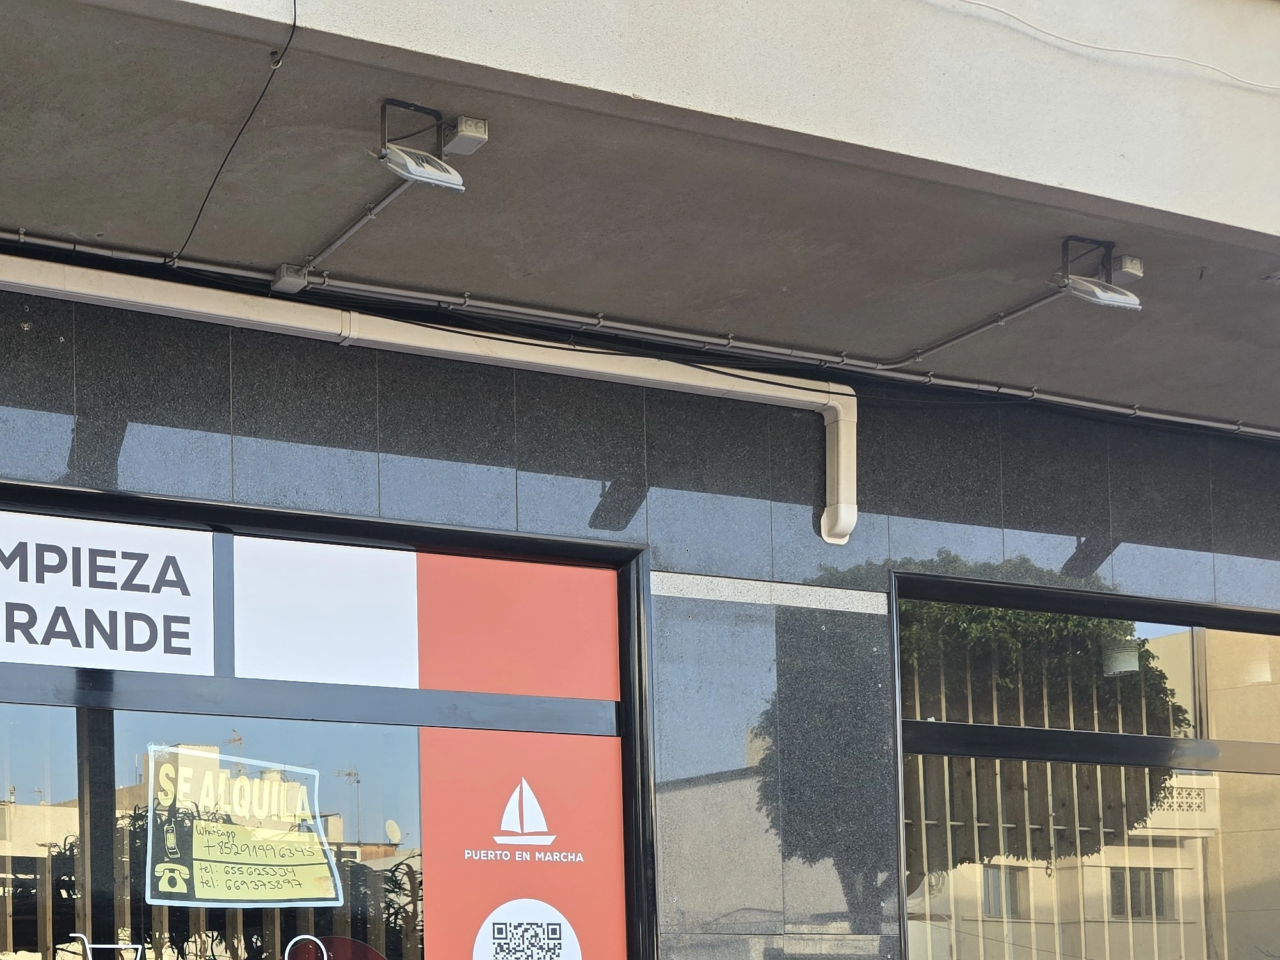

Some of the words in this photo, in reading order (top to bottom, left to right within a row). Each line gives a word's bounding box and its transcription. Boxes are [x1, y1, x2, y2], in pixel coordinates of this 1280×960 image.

[158, 763, 193, 808] SE
[198, 770, 315, 825] ALQUILA
[464, 850, 510, 861] PUERTO
[515, 851, 530, 861] EN
[535, 852, 584, 862] MARCHA
[199, 863, 218, 874] tel:
[199, 875, 219, 888] tel:
